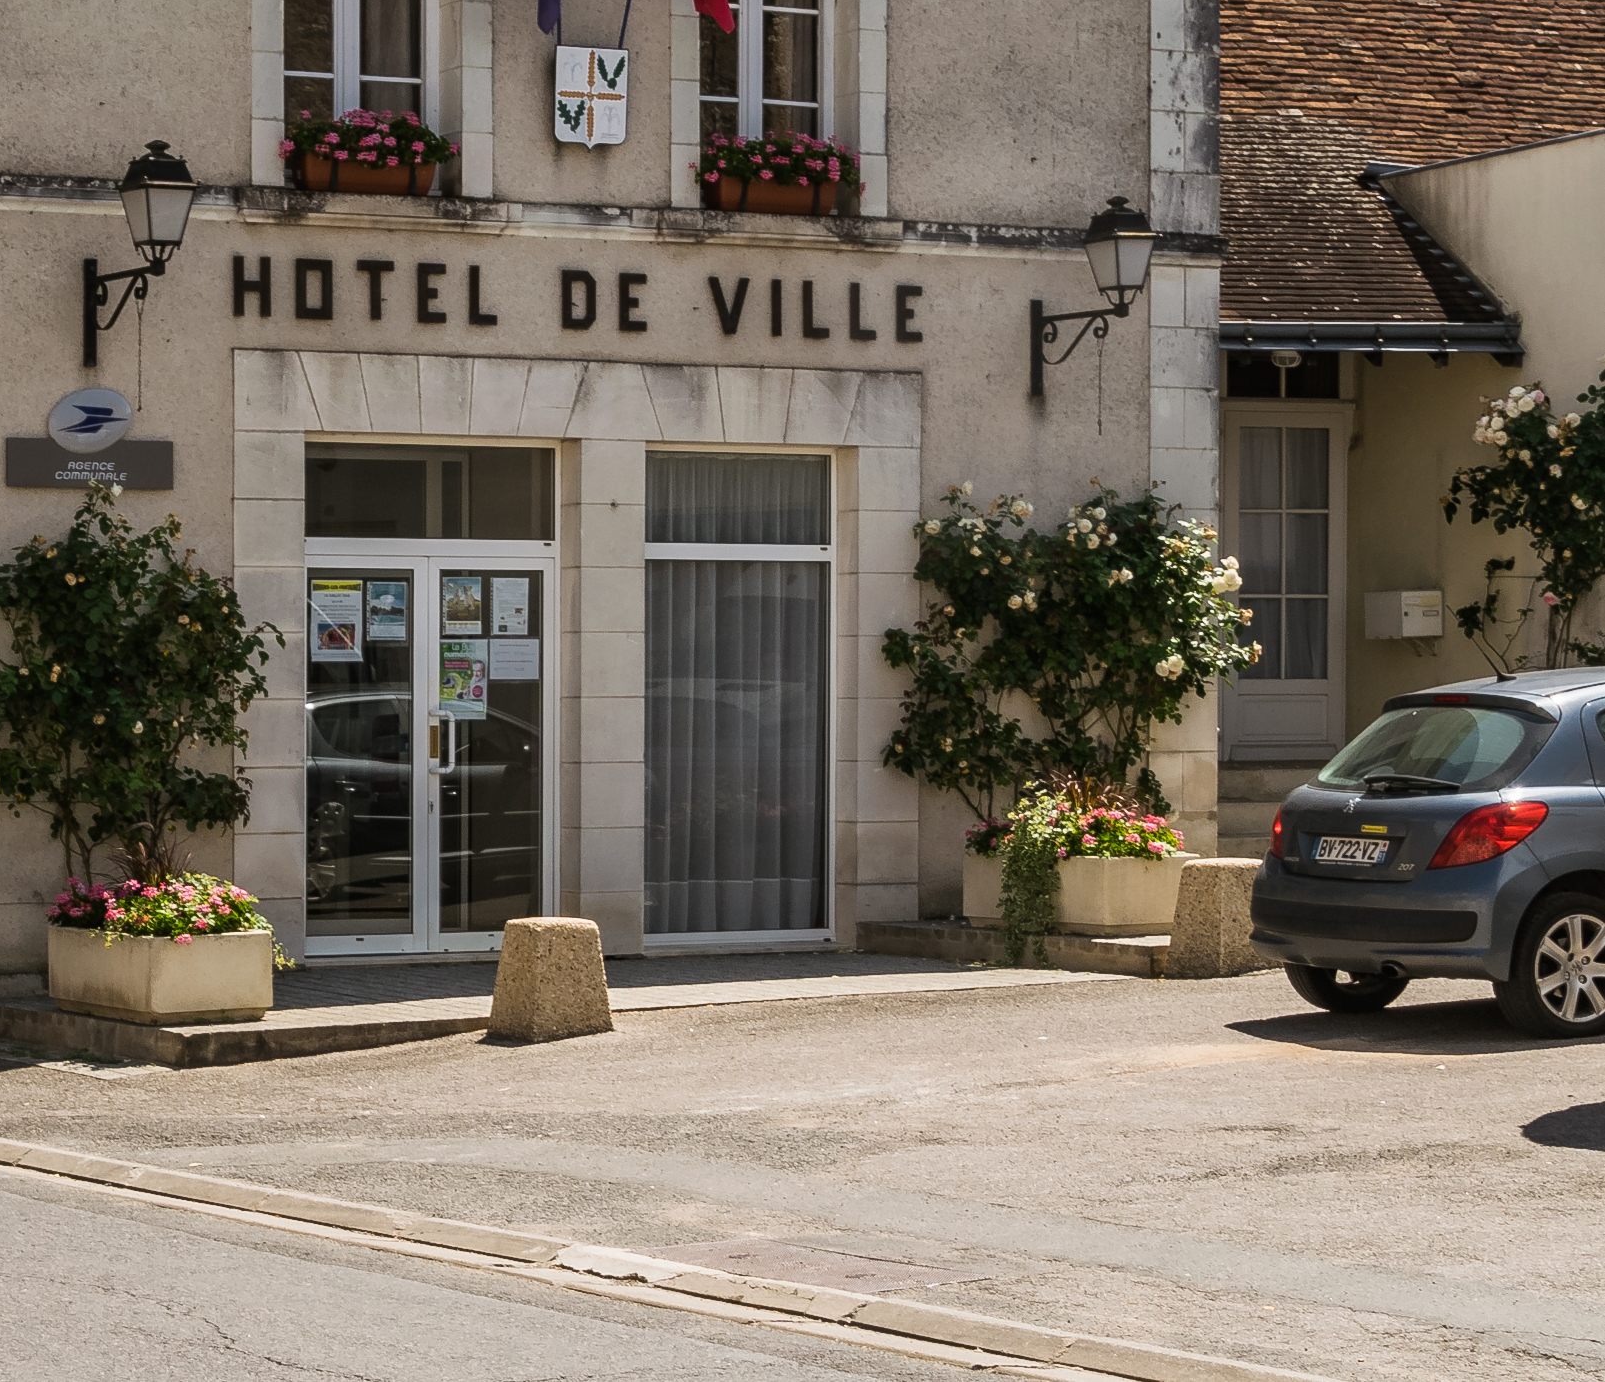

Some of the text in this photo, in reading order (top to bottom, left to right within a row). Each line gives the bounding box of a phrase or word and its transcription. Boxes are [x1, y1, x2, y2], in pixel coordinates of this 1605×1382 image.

[232, 255, 924, 343] HOTEL DE VILLE
[67, 461, 116, 471] AGENCE
[54, 470, 128, 482] COMMUNALE
[1317, 838, 1380, 861] BV-722-VZ
[1397, 863, 1415, 871] 207
